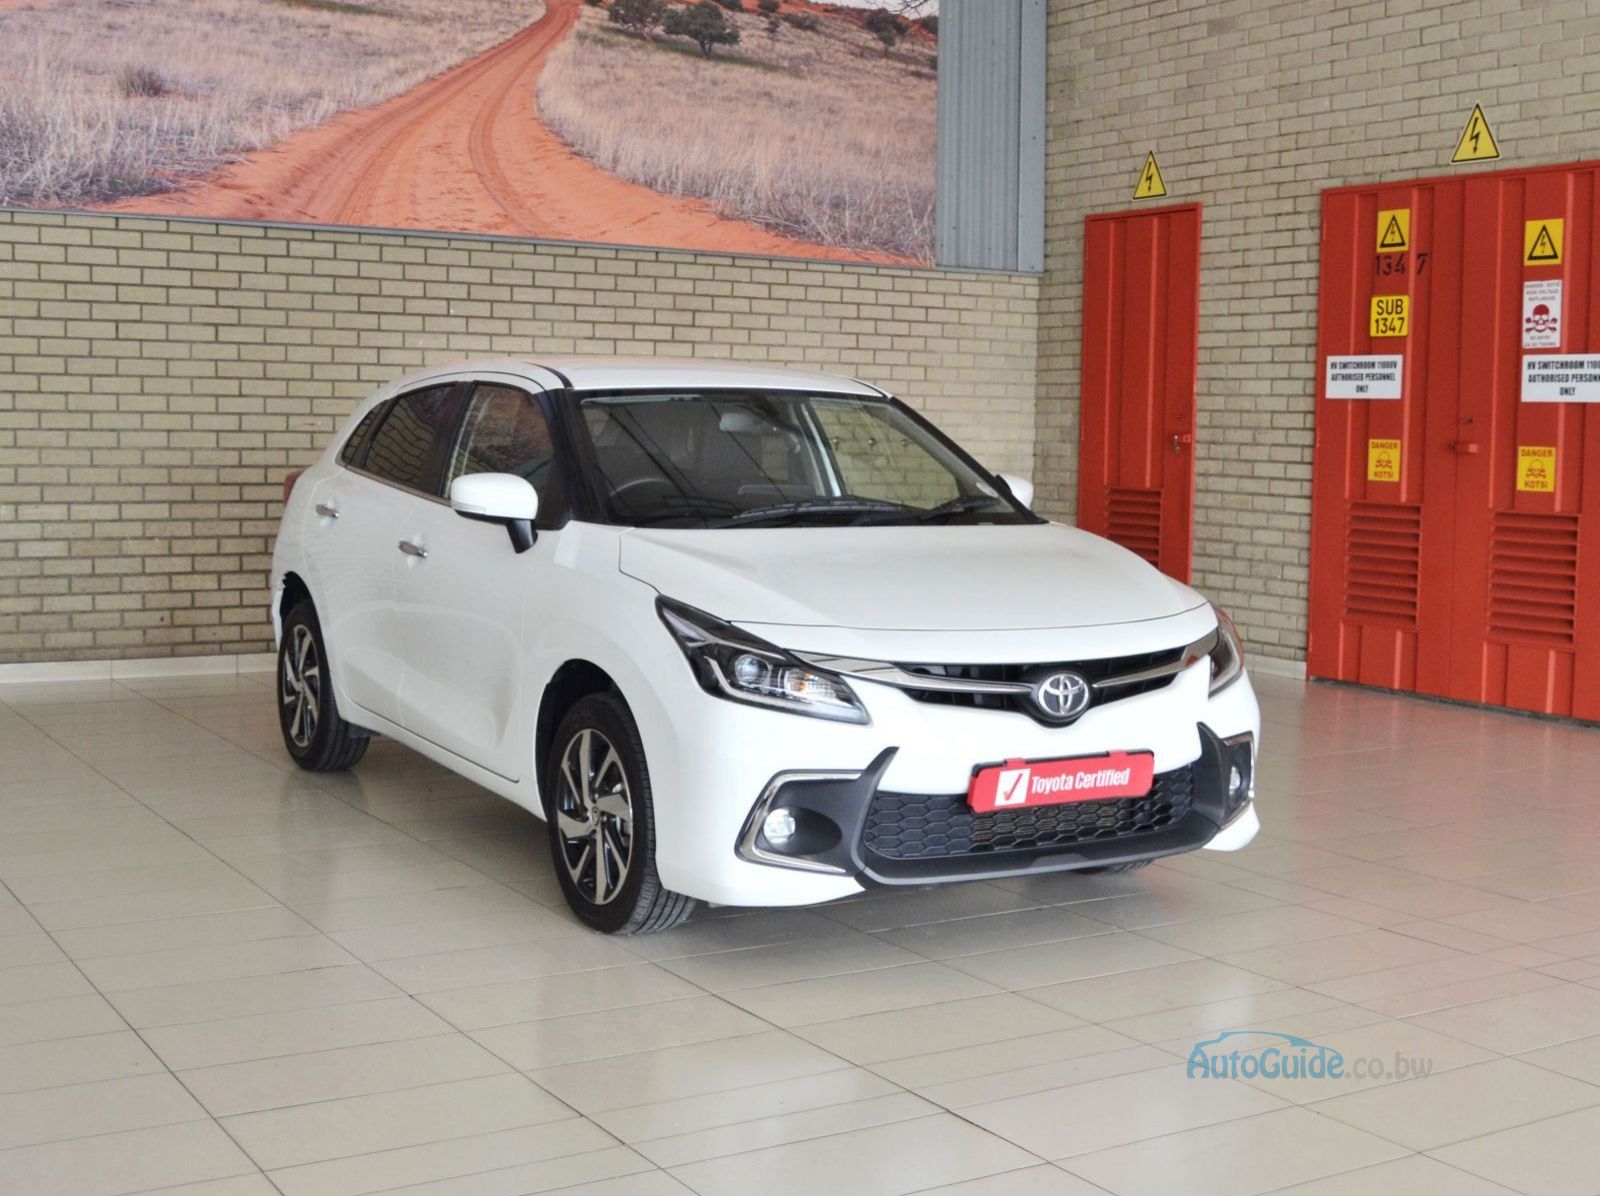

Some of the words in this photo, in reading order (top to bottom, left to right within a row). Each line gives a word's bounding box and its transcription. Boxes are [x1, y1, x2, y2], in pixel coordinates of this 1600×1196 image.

[1376, 298, 1404, 316] SUB
[1374, 317, 1405, 334] 1347
[1339, 361, 1376, 370] SWITCHROOM
[1538, 360, 1585, 370] SWITCHROOM
[1331, 372, 1364, 382] AUTHORISED
[1365, 372, 1396, 382] PERSONNEL
[1528, 373, 1570, 383] AUTHORISED
[1356, 384, 1369, 393] ONLY
[1559, 386, 1576, 396] ONLY
[1521, 448, 1553, 458] DANGER
[1031, 773, 1075, 796] Toyota
[1074, 767, 1131, 790] Certified
